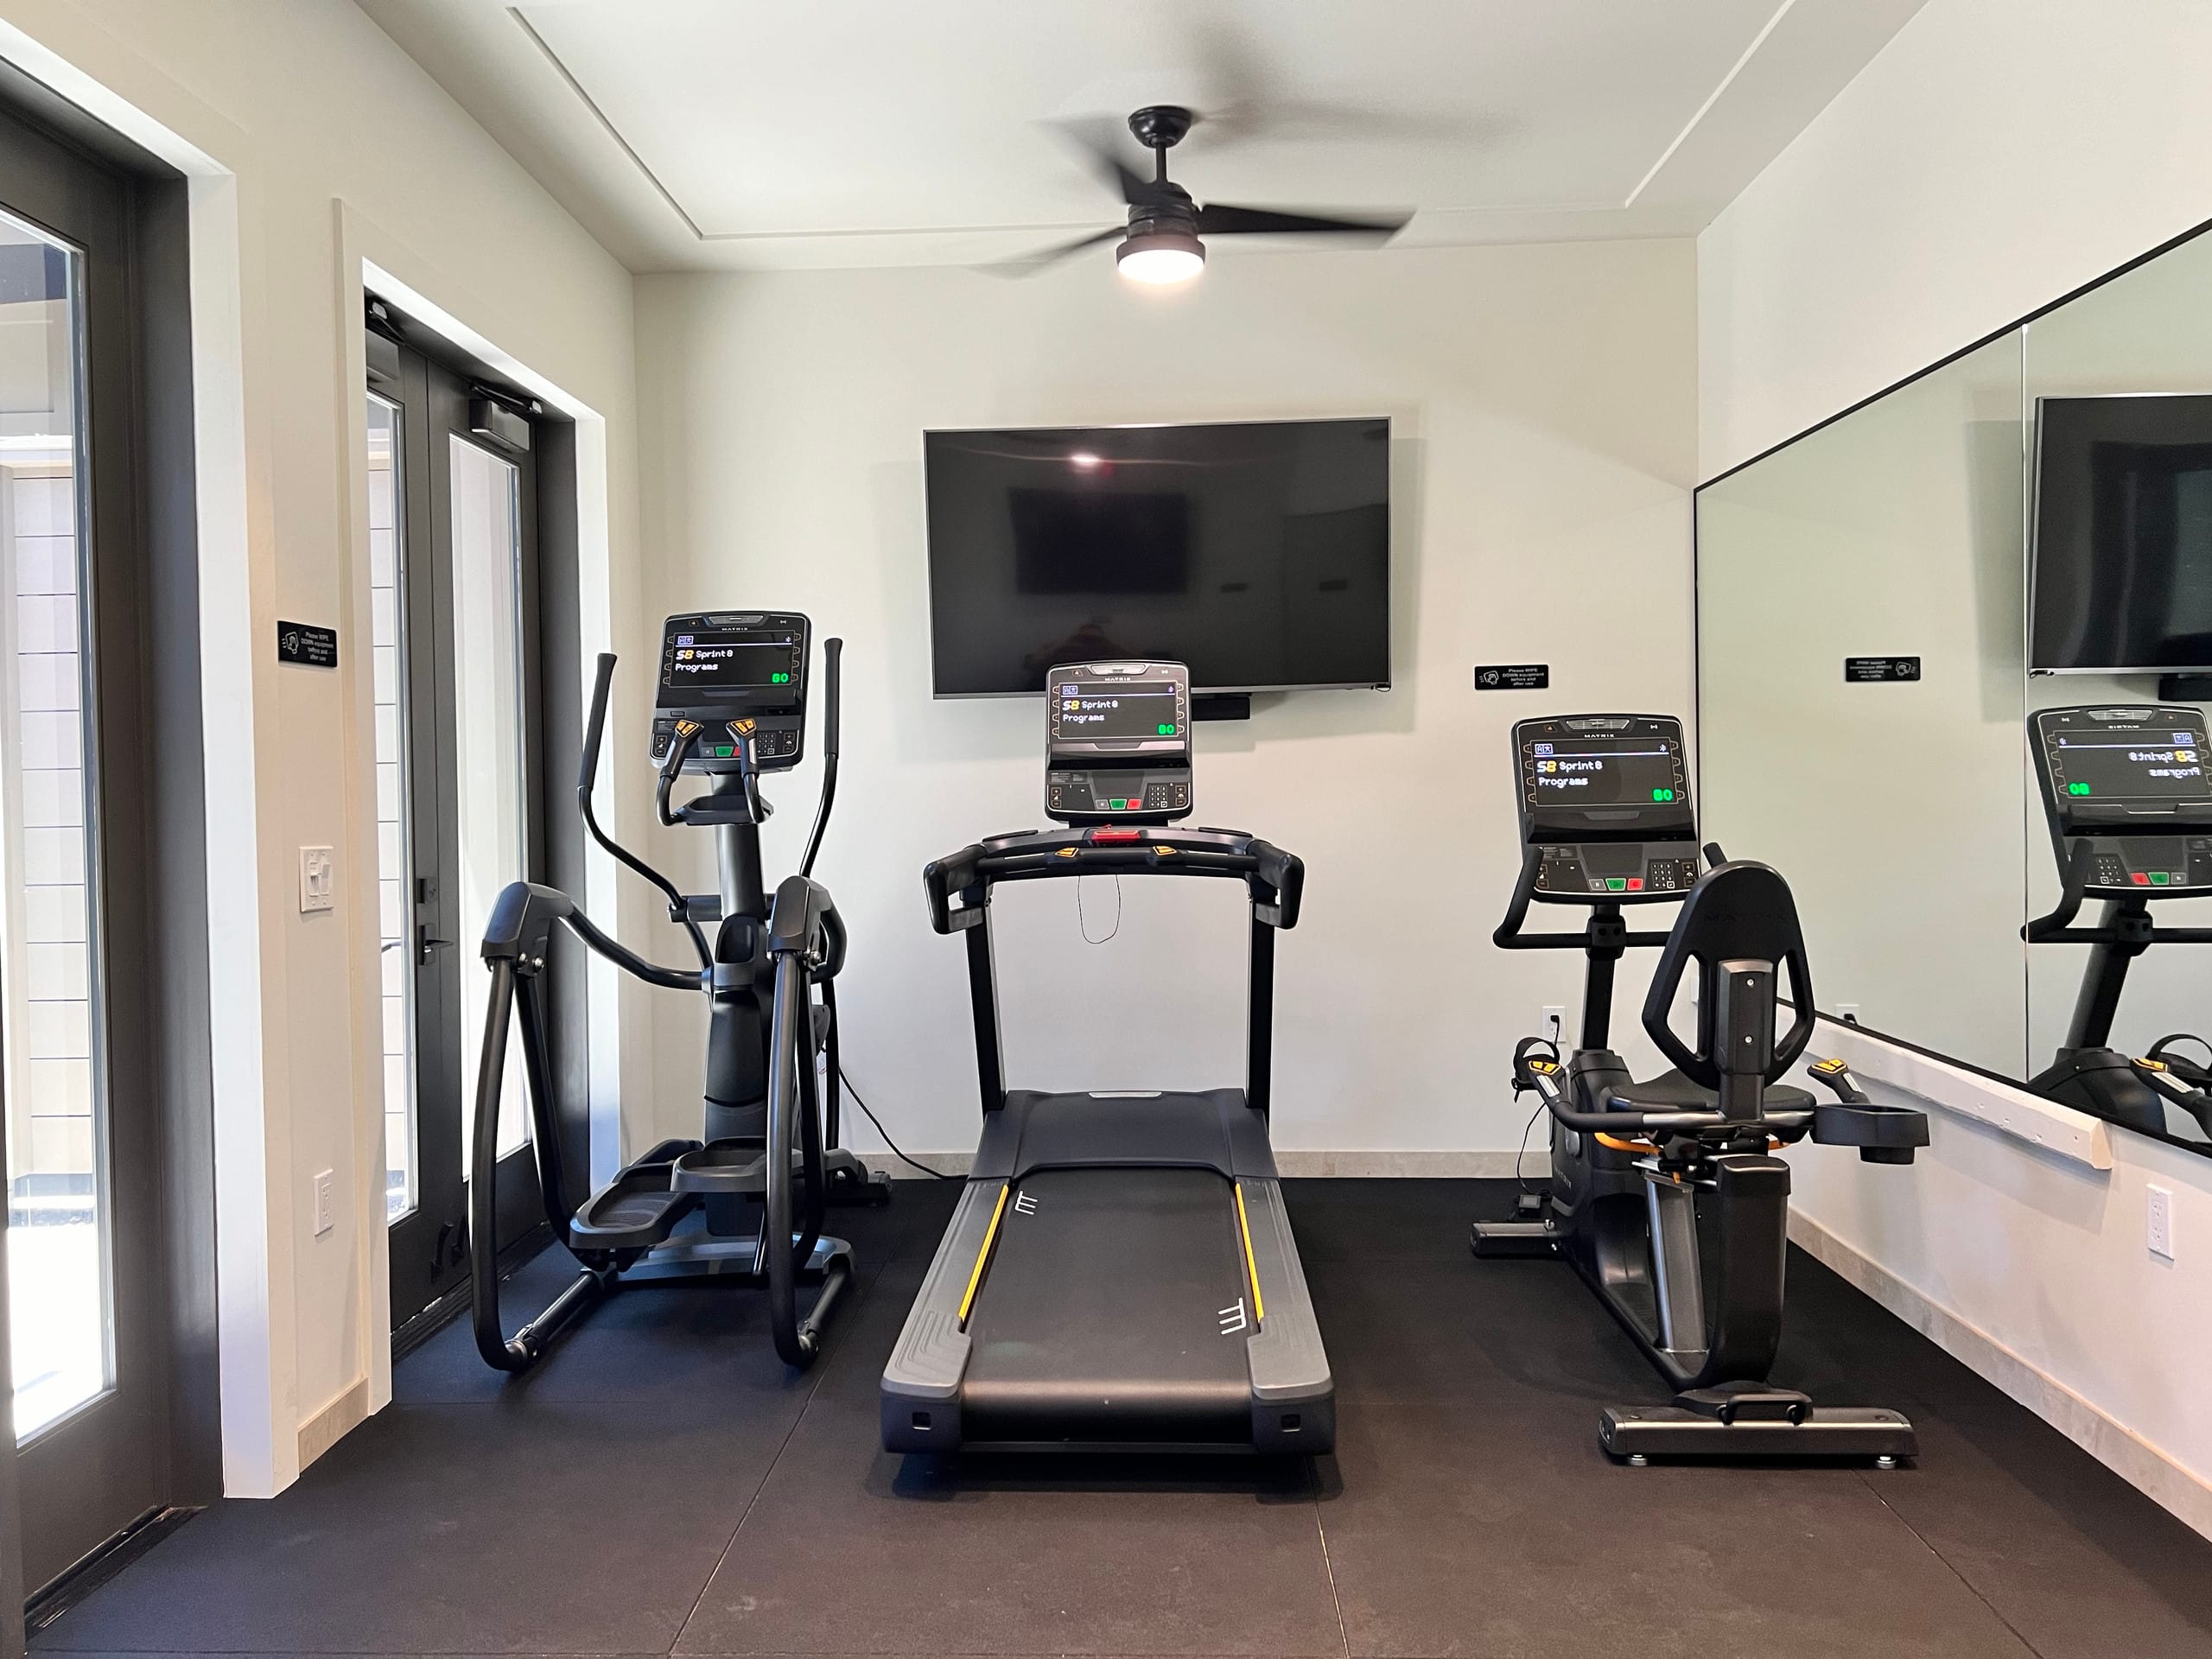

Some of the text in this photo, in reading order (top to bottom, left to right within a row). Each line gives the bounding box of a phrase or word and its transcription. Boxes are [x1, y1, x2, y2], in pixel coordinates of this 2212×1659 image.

[696, 650, 726, 659] Sprint
[676, 664, 718, 673] Programs
[1081, 700, 1110, 710] Sprint
[1062, 714, 1105, 723] Programs
[1559, 760, 1594, 771] Sprint
[1538, 777, 1588, 788] Programs
